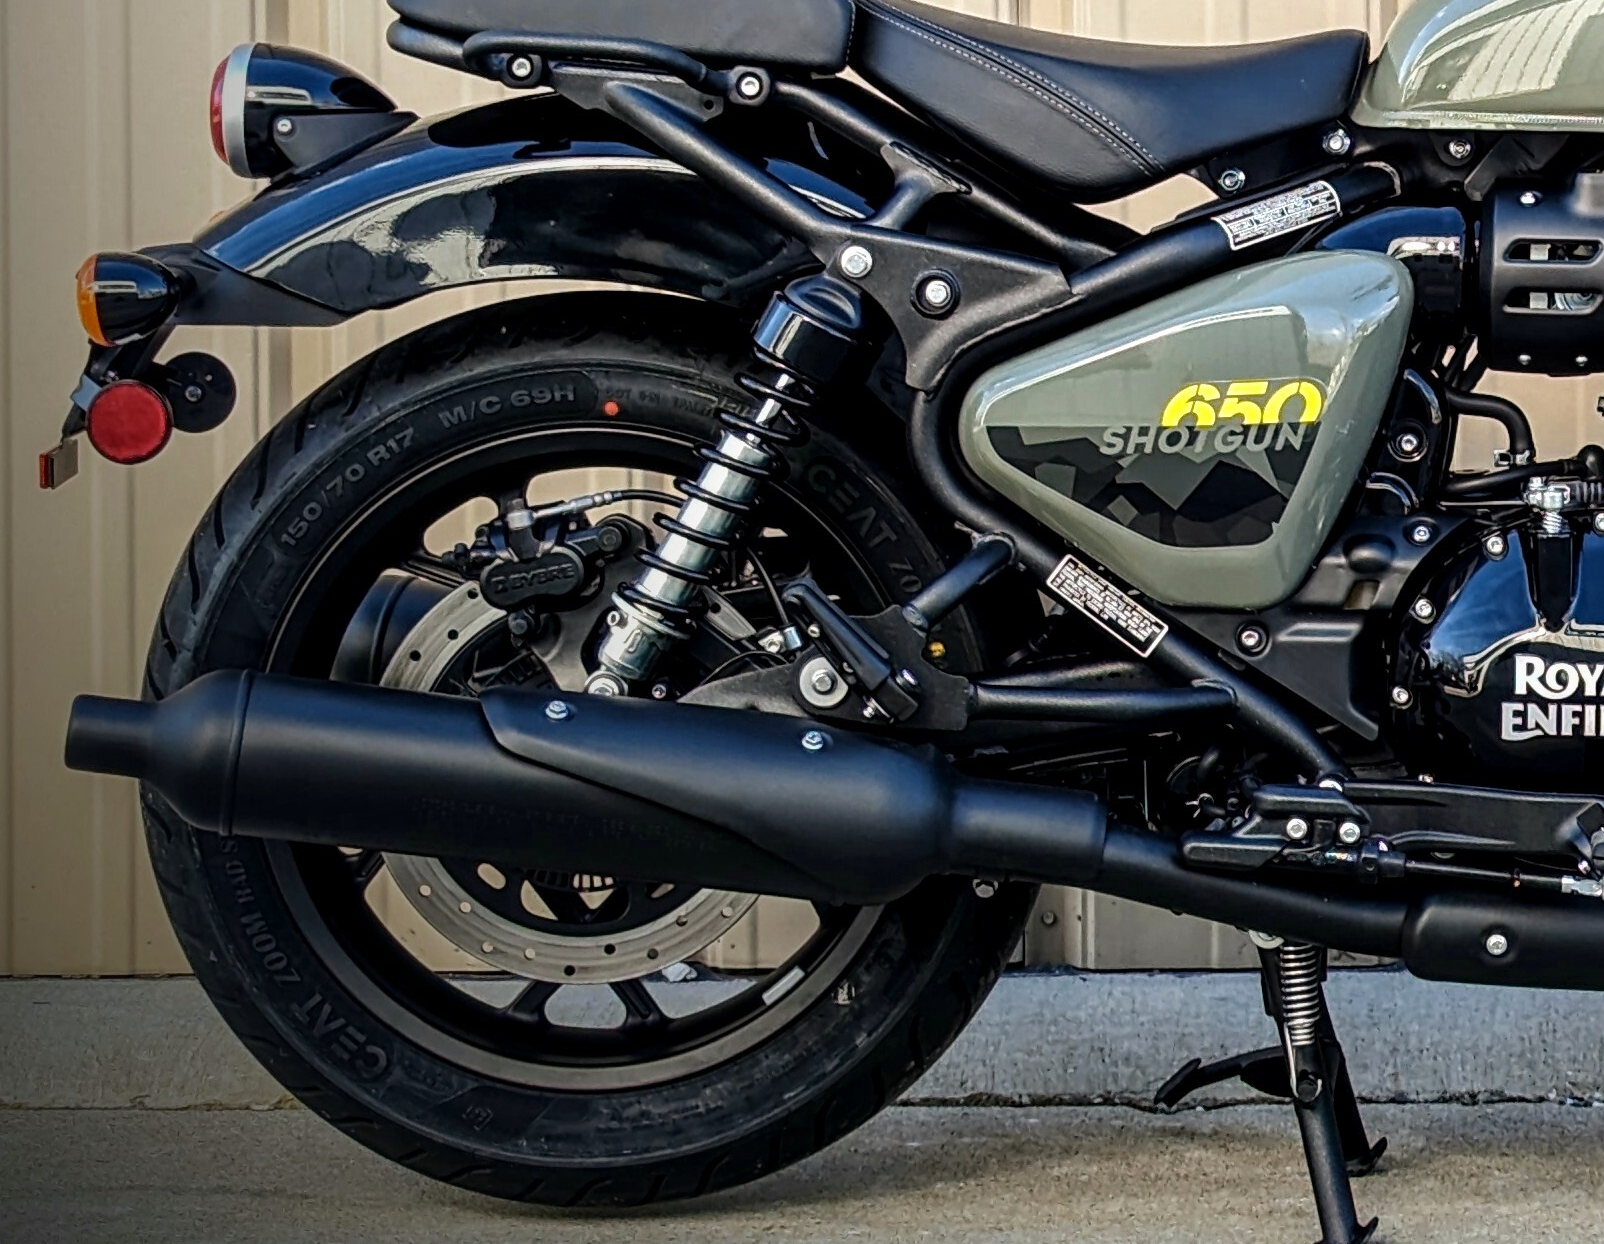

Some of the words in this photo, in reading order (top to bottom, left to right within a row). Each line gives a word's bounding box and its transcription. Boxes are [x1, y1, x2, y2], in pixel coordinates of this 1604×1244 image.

[1099, 424, 1308, 455] SHOTGUN
[1161, 380, 1323, 428] 650
[279, 464, 367, 548] 150/70
[366, 426, 416, 468] R17
[437, 394, 502, 430] M/C
[510, 382, 576, 408] 69H
[806, 464, 900, 550] CEAT
[238, 910, 302, 988] ZOOM
[290, 991, 389, 1077] CEAT
